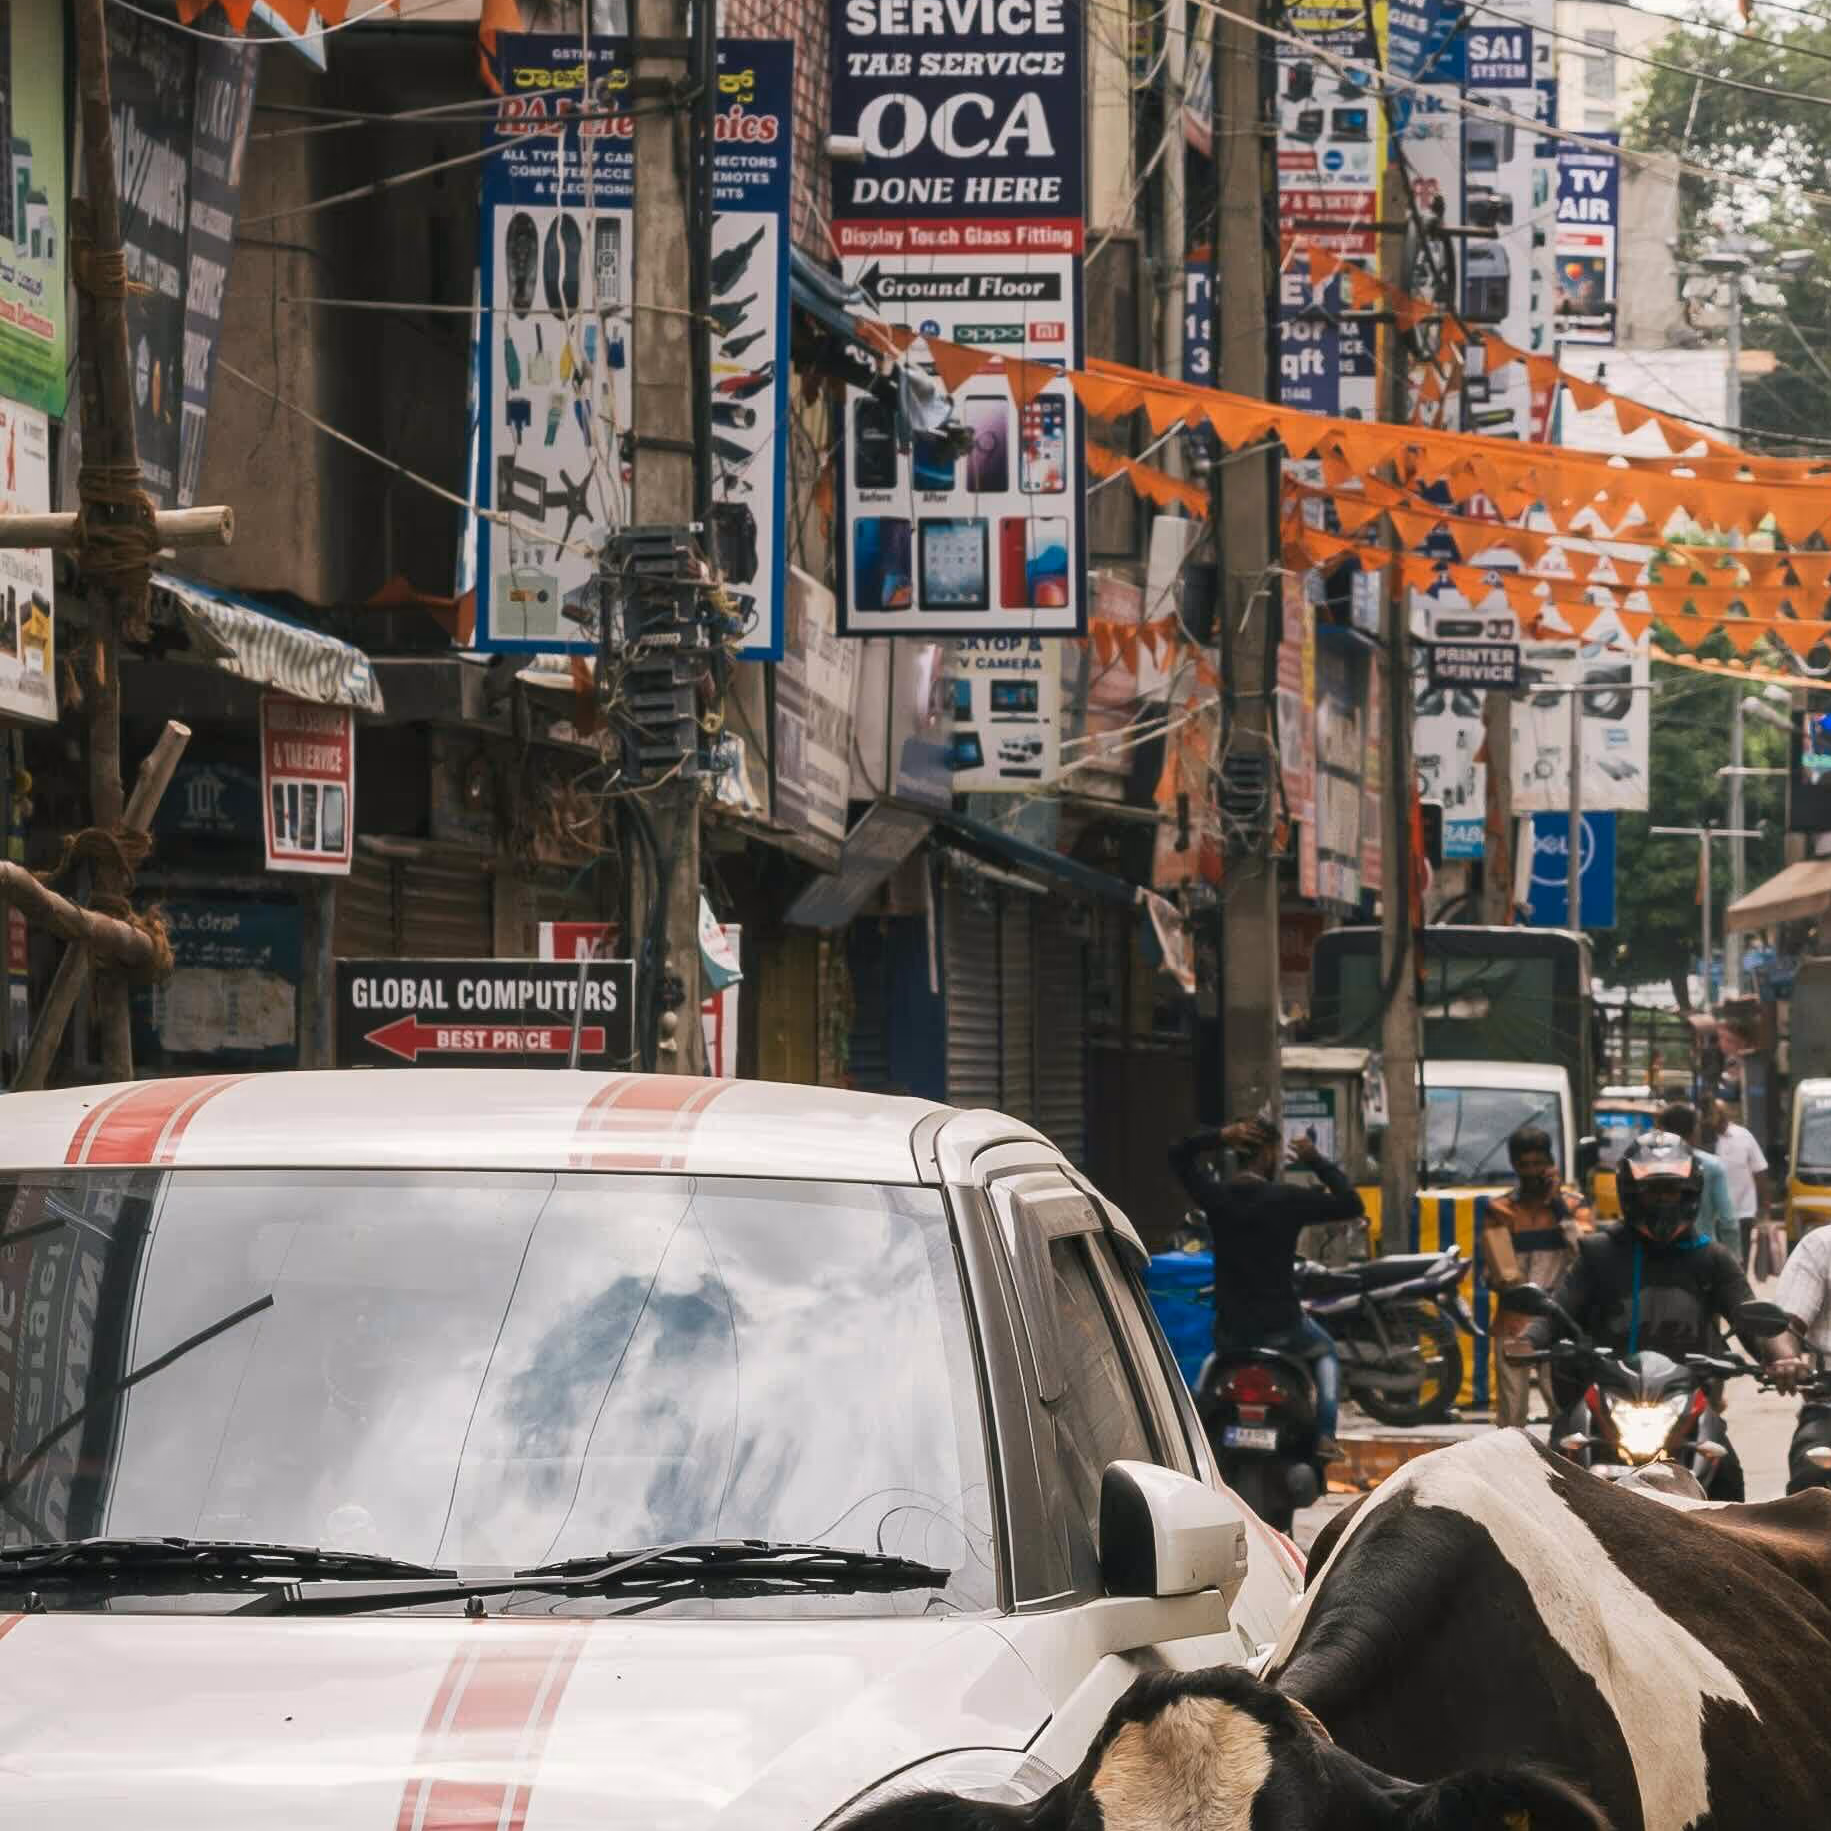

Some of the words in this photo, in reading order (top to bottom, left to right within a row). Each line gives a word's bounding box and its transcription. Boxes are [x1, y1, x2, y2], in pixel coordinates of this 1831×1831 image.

[1468, 34, 1524, 61] SAI
[848, 52, 911, 77] TAB
[918, 52, 1066, 77] SERVICE
[857, 91, 1056, 160] OCA
[502, 148, 529, 163] ALL
[851, 177, 955, 204] DONE
[964, 177, 1062, 204] HERE
[1568, 169, 1607, 193] TV
[841, 226, 904, 249] Display
[911, 227, 959, 245] Touch
[965, 229, 1011, 246] Glass
[1015, 230, 1074, 250] Fitting
[875, 278, 970, 299] Ground
[977, 278, 1046, 298] Floor
[1434, 647, 1515, 664] PRINTER
[1435, 665, 1515, 682] SERVICE
[351, 977, 449, 1011] GLOBAL
[435, 1029, 484, 1049] BEST
[491, 1030, 553, 1050] PRICE
